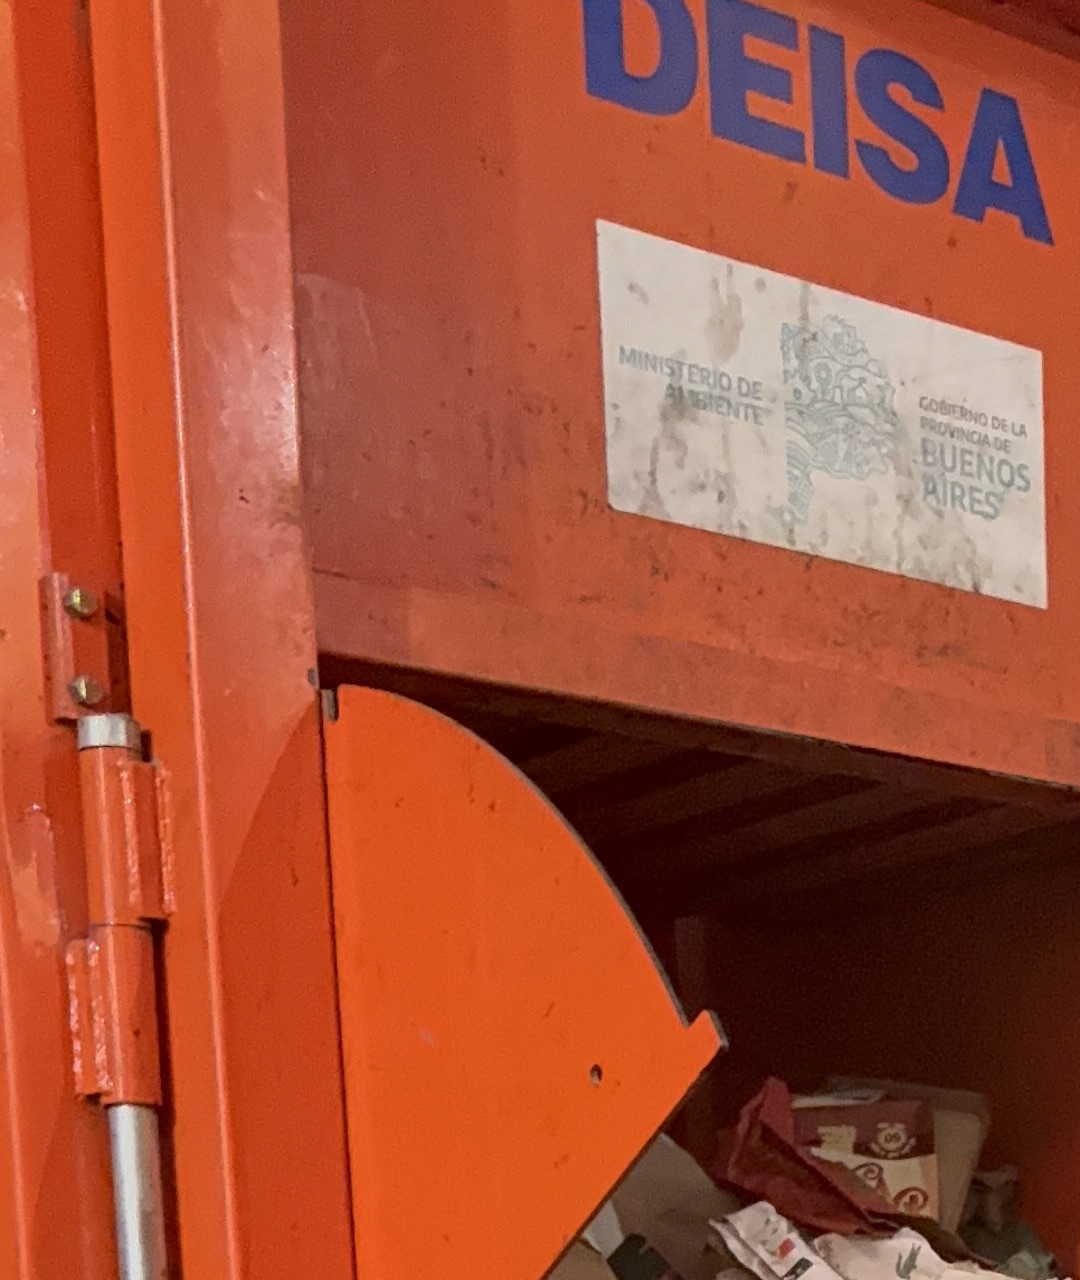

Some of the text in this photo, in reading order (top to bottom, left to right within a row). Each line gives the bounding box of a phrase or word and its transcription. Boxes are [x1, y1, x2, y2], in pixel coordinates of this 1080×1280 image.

[581, 0, 1054, 247] DEISA
[618, 344, 763, 401] MINISTERIO DE
[664, 383, 765, 426] AMBIENTE
[919, 396, 1028, 439] GOBIERNO DE LA
[920, 415, 1011, 454] PROVINCIA DE
[921, 437, 1031, 492] BUENOS
[922, 472, 1000, 520] AIRES
